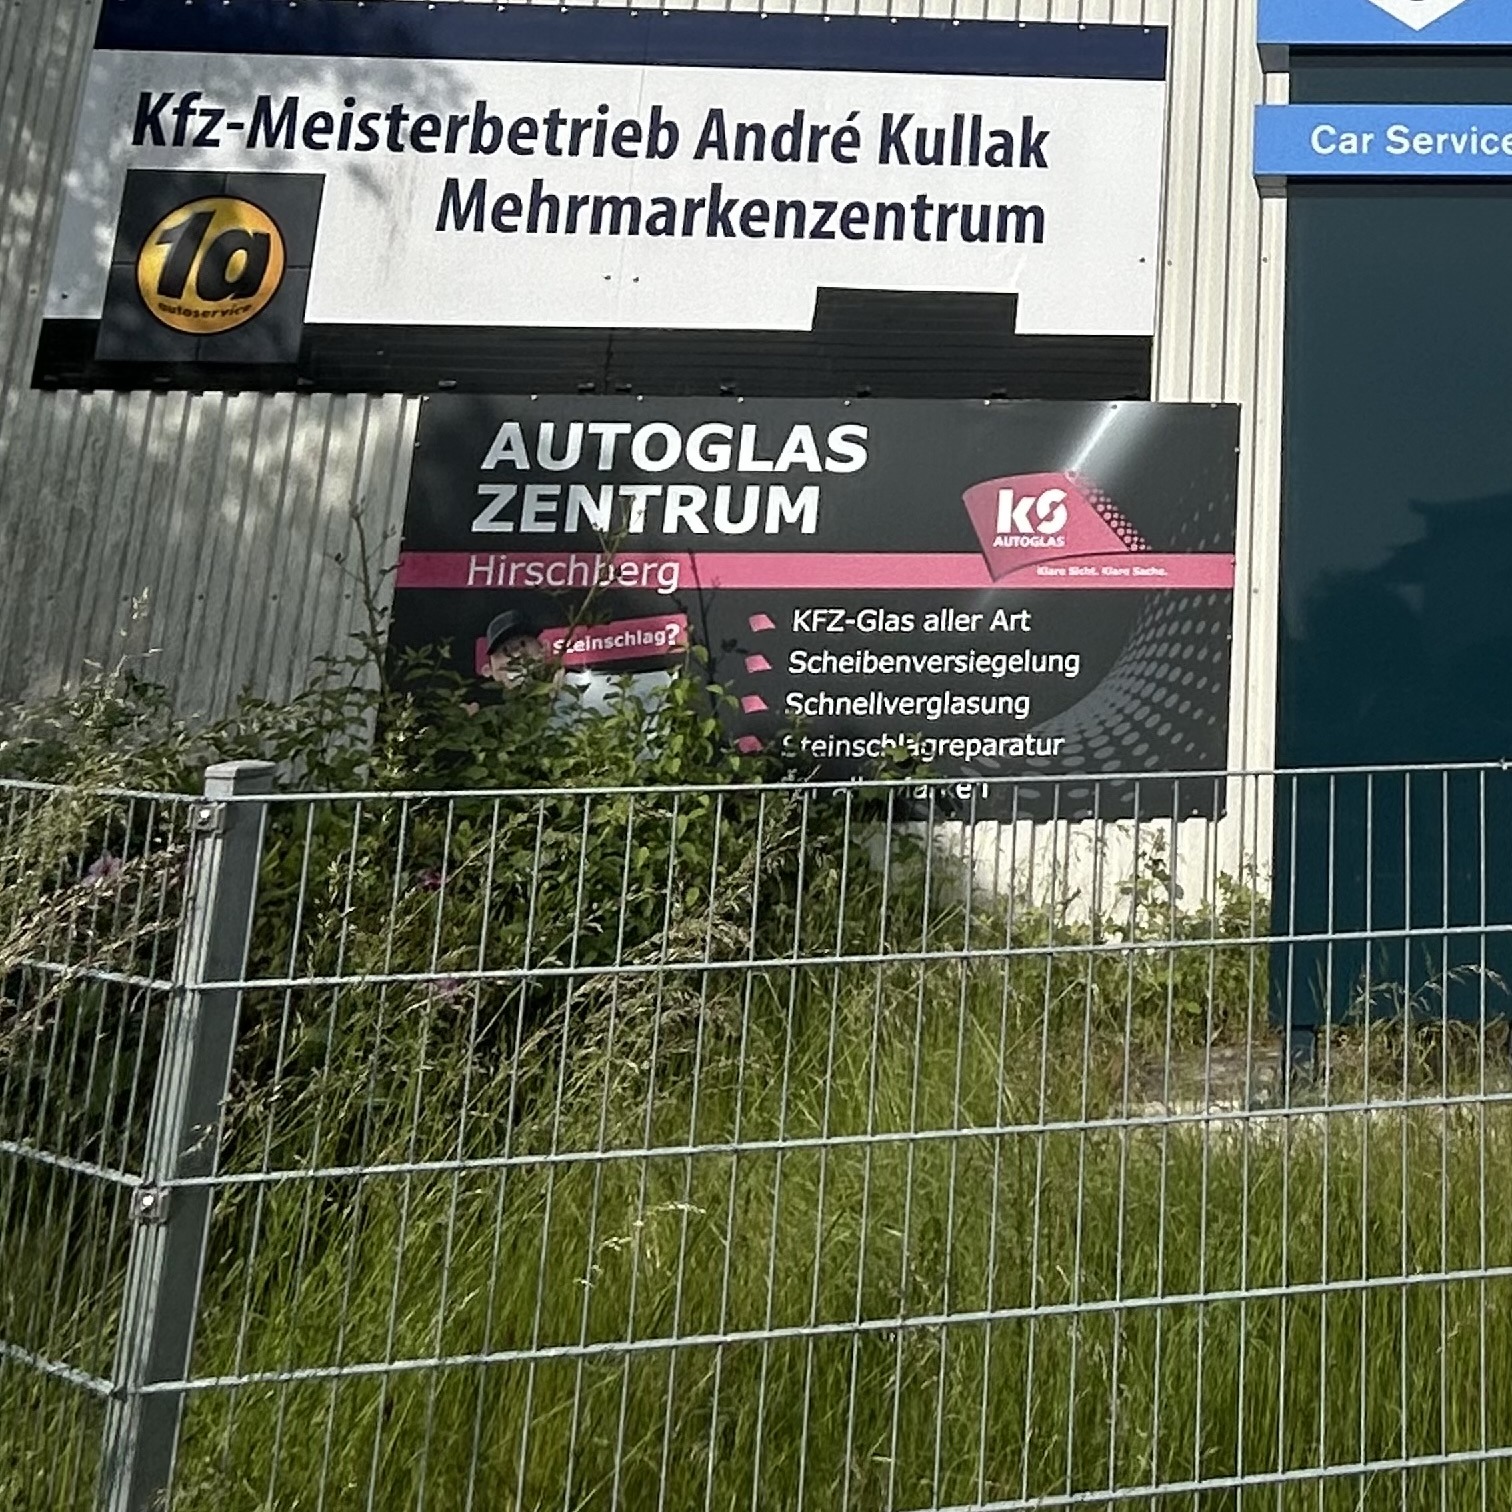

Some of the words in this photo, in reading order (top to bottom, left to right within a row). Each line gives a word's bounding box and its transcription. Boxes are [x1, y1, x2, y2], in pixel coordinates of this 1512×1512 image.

[132, 90, 680, 162] Kfz-Meisterbetrieb
[693, 108, 862, 164] André
[878, 112, 1051, 169] Kullak
[1311, 124, 1375, 156] Car
[435, 178, 1047, 244] Mehrmarkenzentrum
[156, 209, 271, 302] 1a
[158, 302, 253, 319] autoservice
[481, 420, 869, 473] AUTOGLAS
[471, 484, 821, 535] ZENTRUM
[993, 535, 1066, 548] AUTOGLAS
[467, 554, 681, 595] Hirschberg
[792, 608, 914, 633] KFZ-Glas
[923, 608, 983, 633] aller
[990, 608, 1031, 633] Art
[788, 649, 1081, 679] Scheibenversiegelung
[784, 691, 1031, 720] Schnellverglasung
